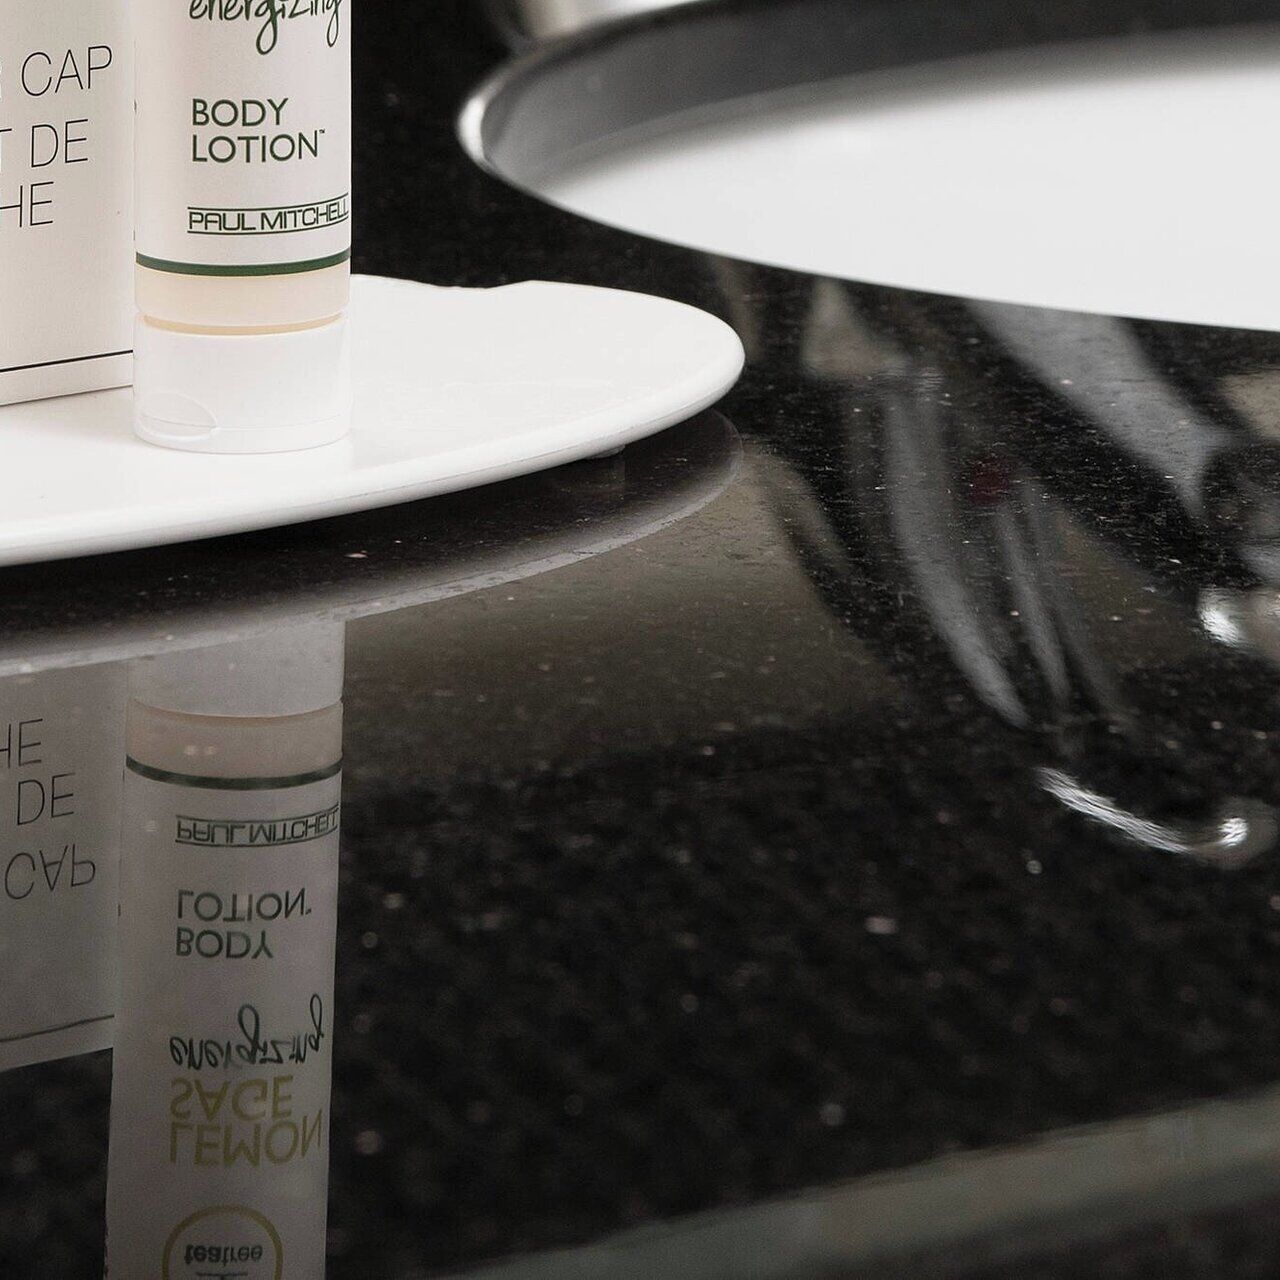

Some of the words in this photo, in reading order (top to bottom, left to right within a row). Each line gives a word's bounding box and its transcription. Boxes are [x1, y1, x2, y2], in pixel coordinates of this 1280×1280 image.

[21, 45, 113, 97] CAP
[192, 98, 289, 127] BODY
[31, 119, 89, 168] DE
[189, 211, 256, 231] PAUL
[261, 198, 349, 230] MITCHELL
